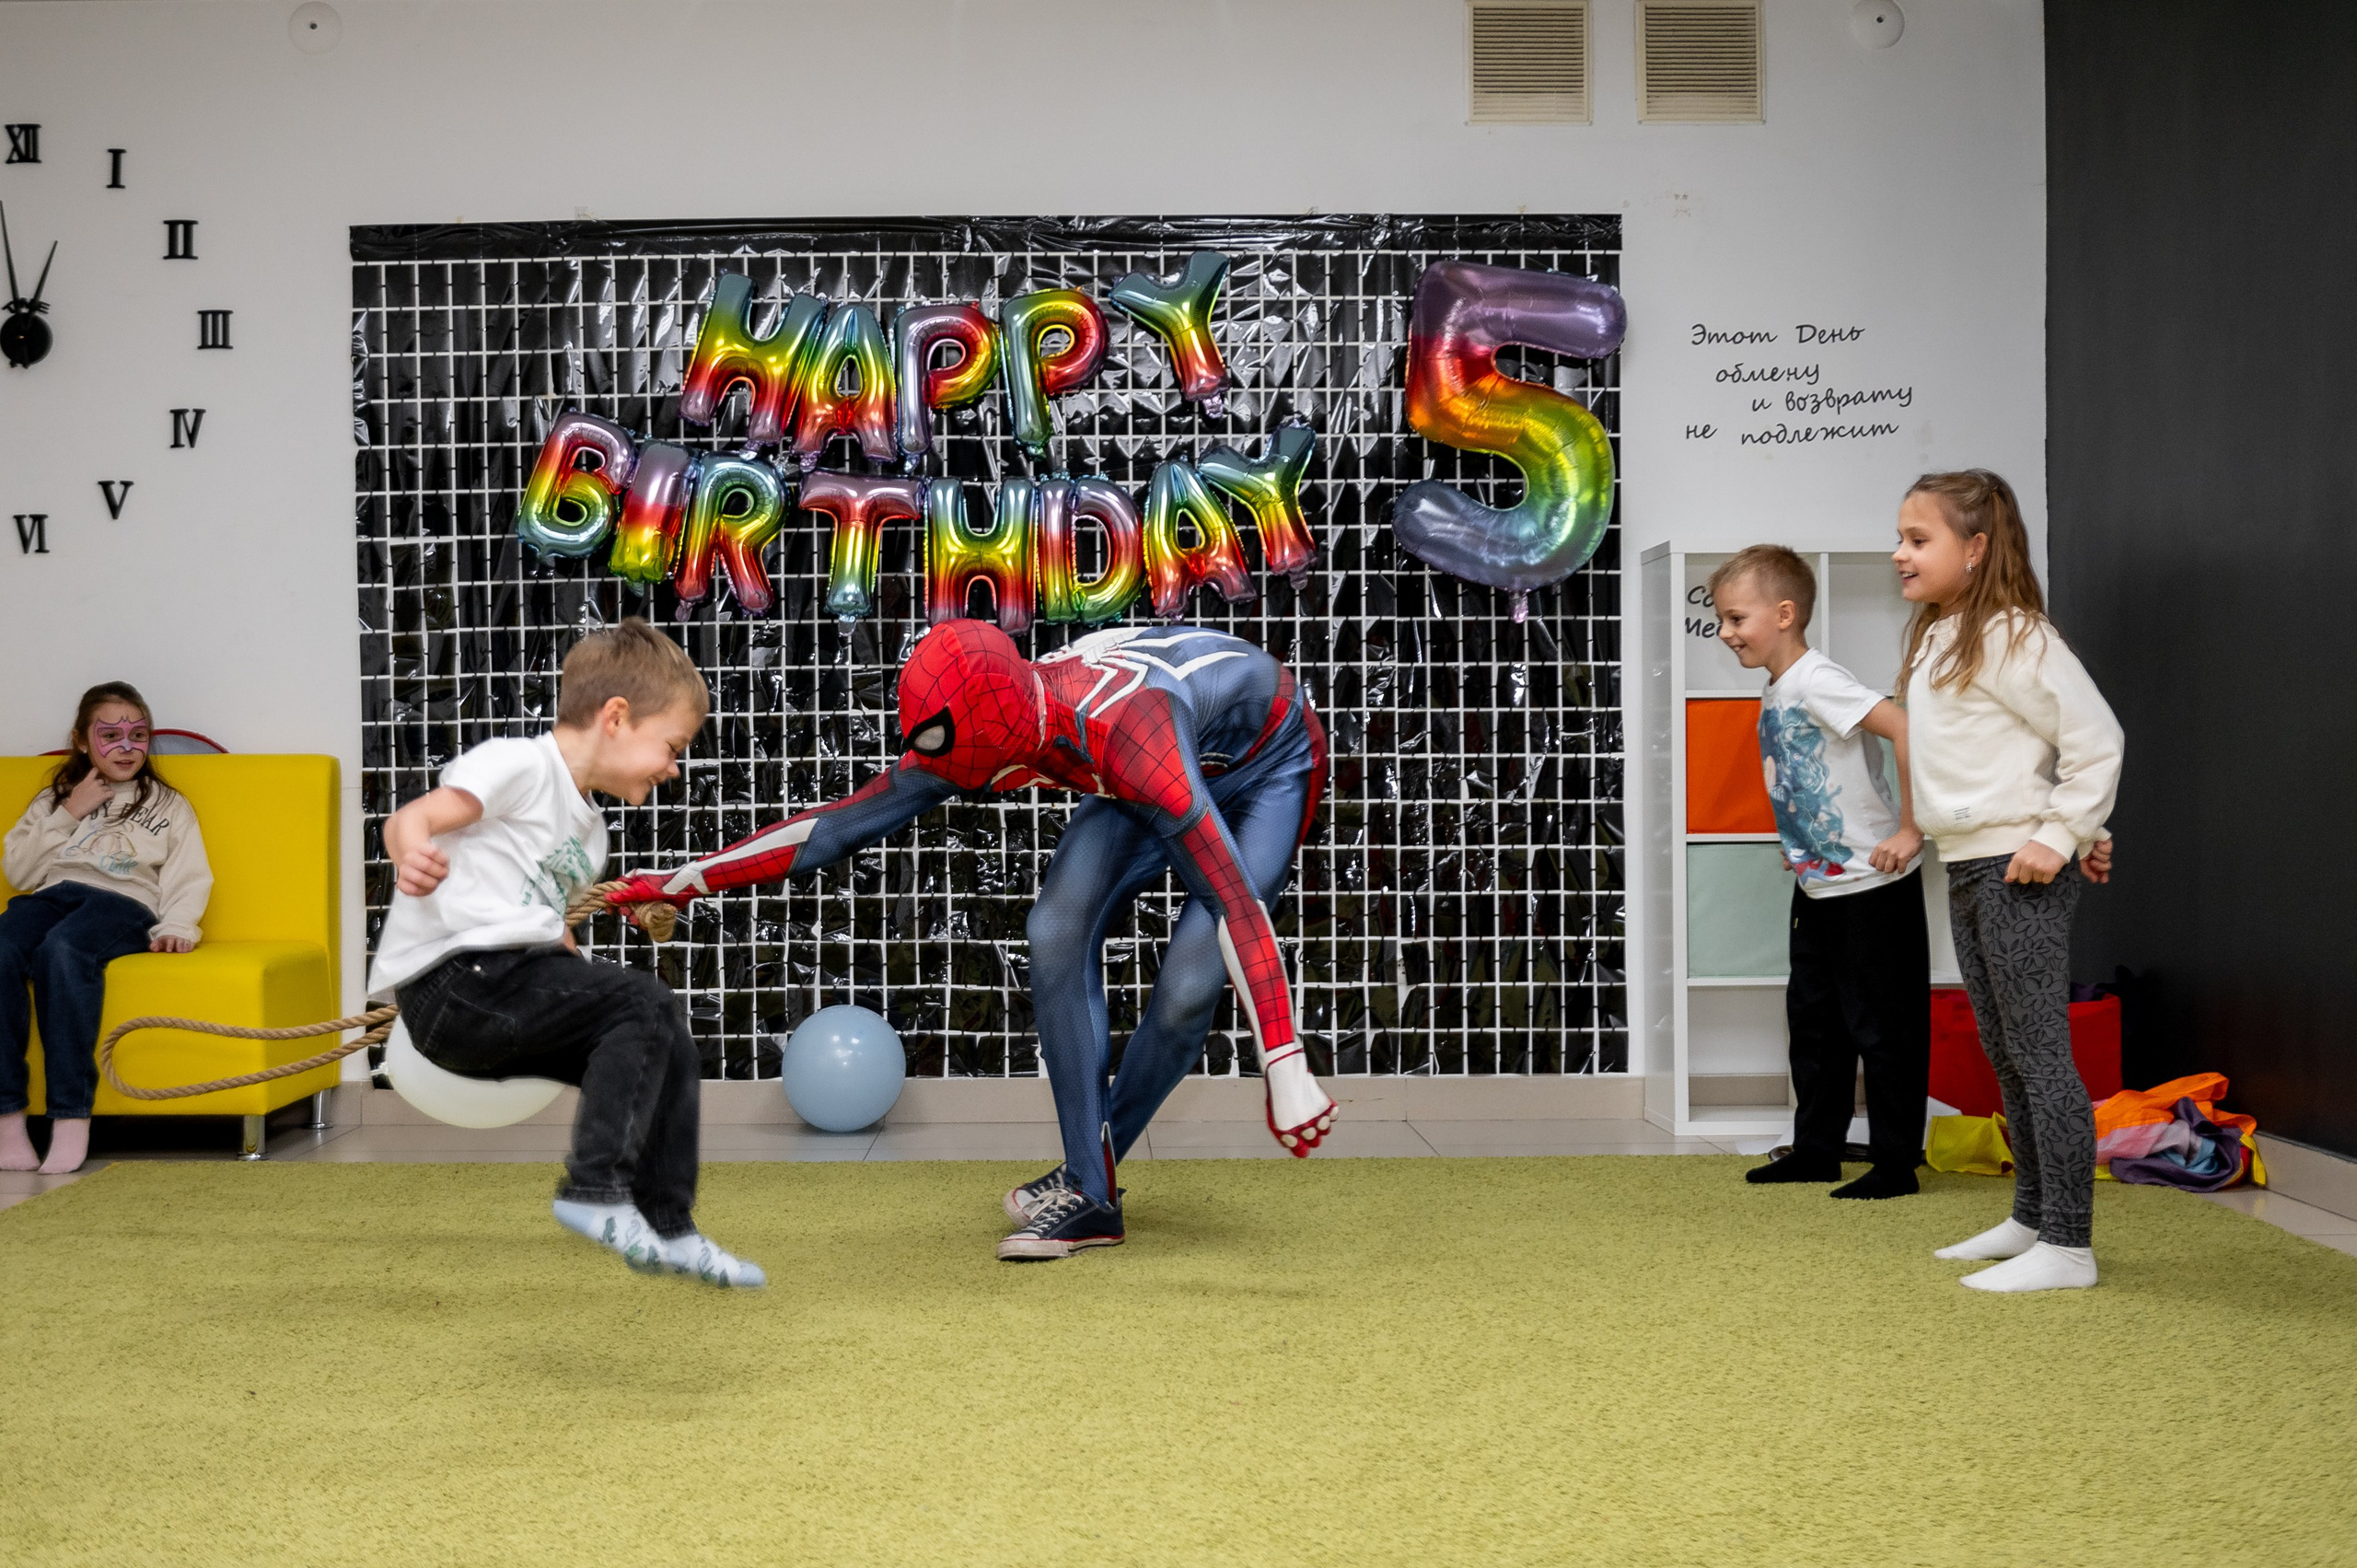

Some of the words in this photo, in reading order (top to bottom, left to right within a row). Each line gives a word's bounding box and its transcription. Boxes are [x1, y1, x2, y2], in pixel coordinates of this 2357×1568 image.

[4, 123, 42, 165] XII
[105, 147, 127, 190] I
[162, 219, 199, 261] II
[197, 309, 234, 350] III
[1690, 323, 1778, 346] Этот
[1795, 324, 1866, 345] День
[679, 251, 1231, 468] HAPPY
[1715, 362, 1820, 386] обмену
[1751, 397, 1772, 412] и
[1785, 386, 1912, 415] возврату
[169, 408, 206, 448] IV
[1392, 261, 1628, 595] 5
[1686, 423, 1718, 439] не
[1741, 423, 1899, 446] подлежит
[97, 480, 134, 520] V
[13, 513, 51, 554] VI
[517, 419, 1320, 635] BIRTHDAY
